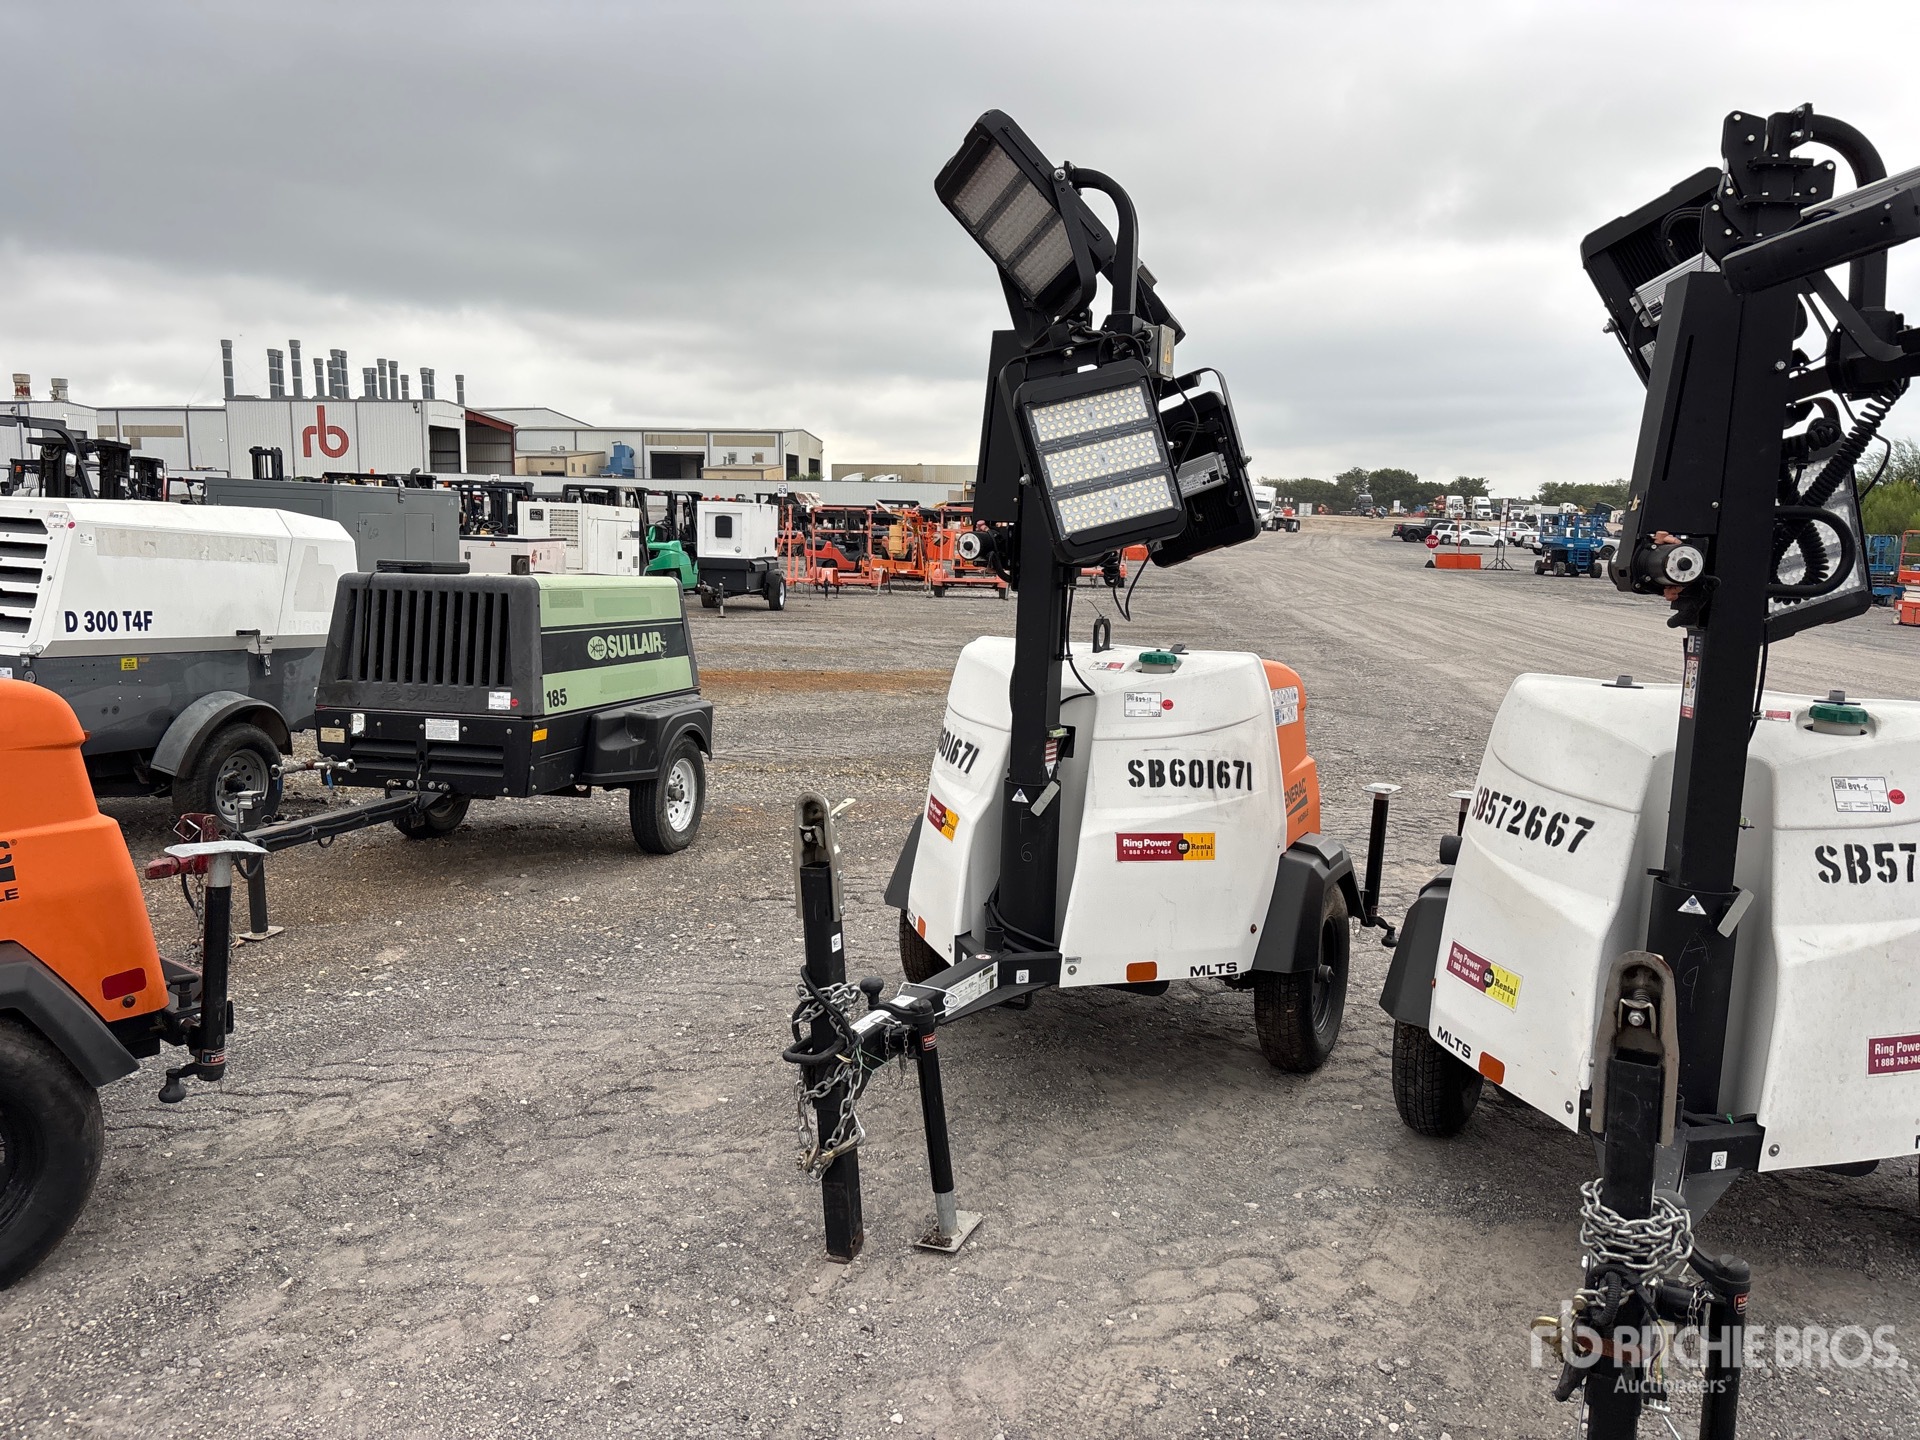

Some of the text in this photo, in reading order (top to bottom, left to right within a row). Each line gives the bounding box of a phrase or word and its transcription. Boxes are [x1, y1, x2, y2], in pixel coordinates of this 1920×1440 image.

[303, 405, 349, 458] rb
[779, 487, 787, 495] 53
[1454, 503, 1464, 511] 55
[64, 611, 153, 632] D 300 T4F
[606, 632, 662, 659] SULLAIR
[547, 688, 567, 708] 185
[1127, 759, 1252, 791] SB601671
[1472, 785, 1595, 854] SB572667
[1123, 839, 1171, 848] Ring Power
[1815, 843, 1917, 884] SB57
[1190, 962, 1238, 977] MLTS
[1453, 947, 1481, 972] Ring Power
[1494, 978, 1517, 996] Rental
[1437, 1025, 1472, 1059] MLTS
[1874, 1043, 1895, 1056] Ring
[1881, 1058, 1895, 1067] 888
